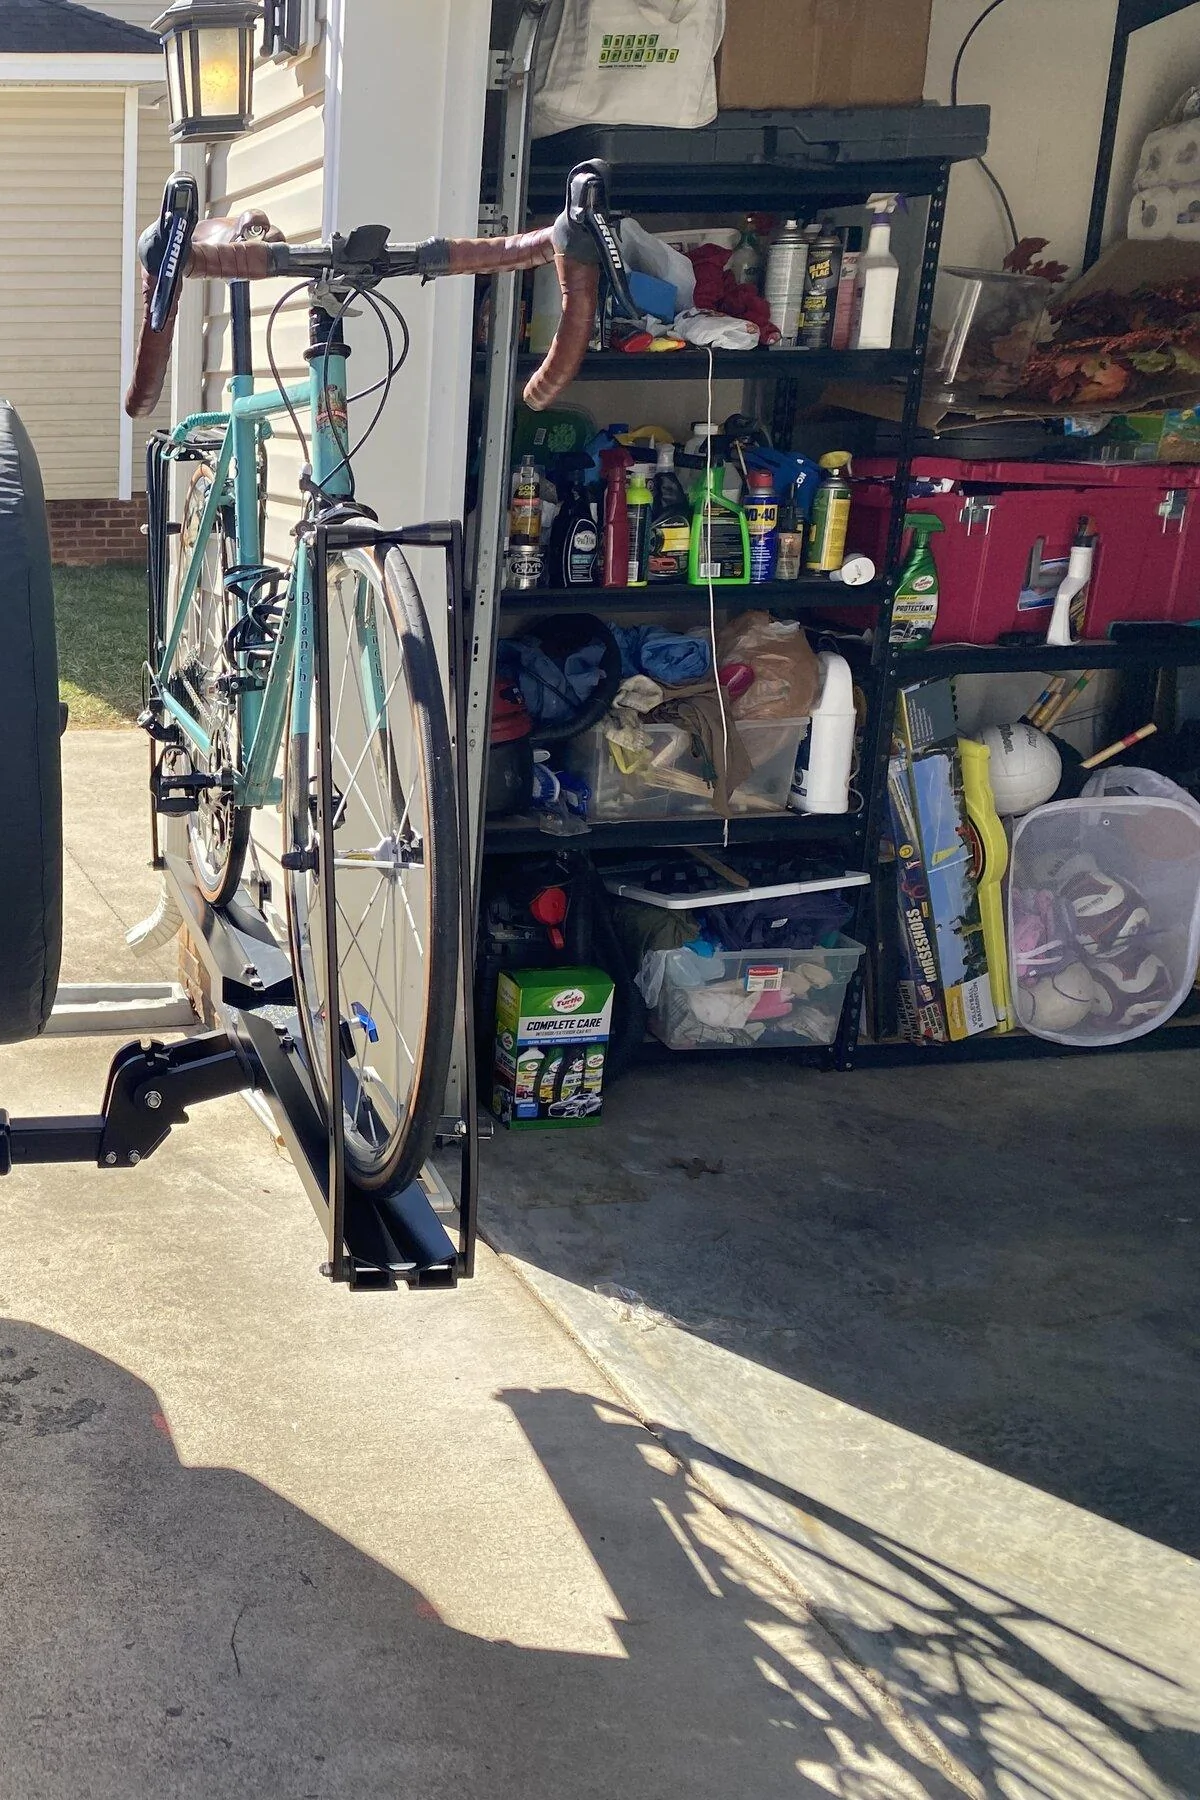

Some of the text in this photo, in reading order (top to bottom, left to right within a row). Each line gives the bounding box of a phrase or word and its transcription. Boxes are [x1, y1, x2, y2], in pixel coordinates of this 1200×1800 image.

[603, 36, 657, 47] GRAND
[600, 50, 677, 61] OPENING
[165, 217, 187, 278] SRAM
[594, 213, 621, 268] SRAM
[809, 260, 831, 274] BLACK
[811, 268, 830, 280] FLAG
[896, 604, 934, 612] PROTECTANT
[300, 591, 310, 699] Bianchi
[906, 908, 937, 982] HORSESHOES
[556, 996, 583, 1006] Turtle
[901, 984, 914, 1010] SPORT
[973, 981, 982, 1021] BADMINTON
[968, 988, 978, 1027] VOLLEYBALL
[526, 1017, 602, 1031] COMPLETE CARE
